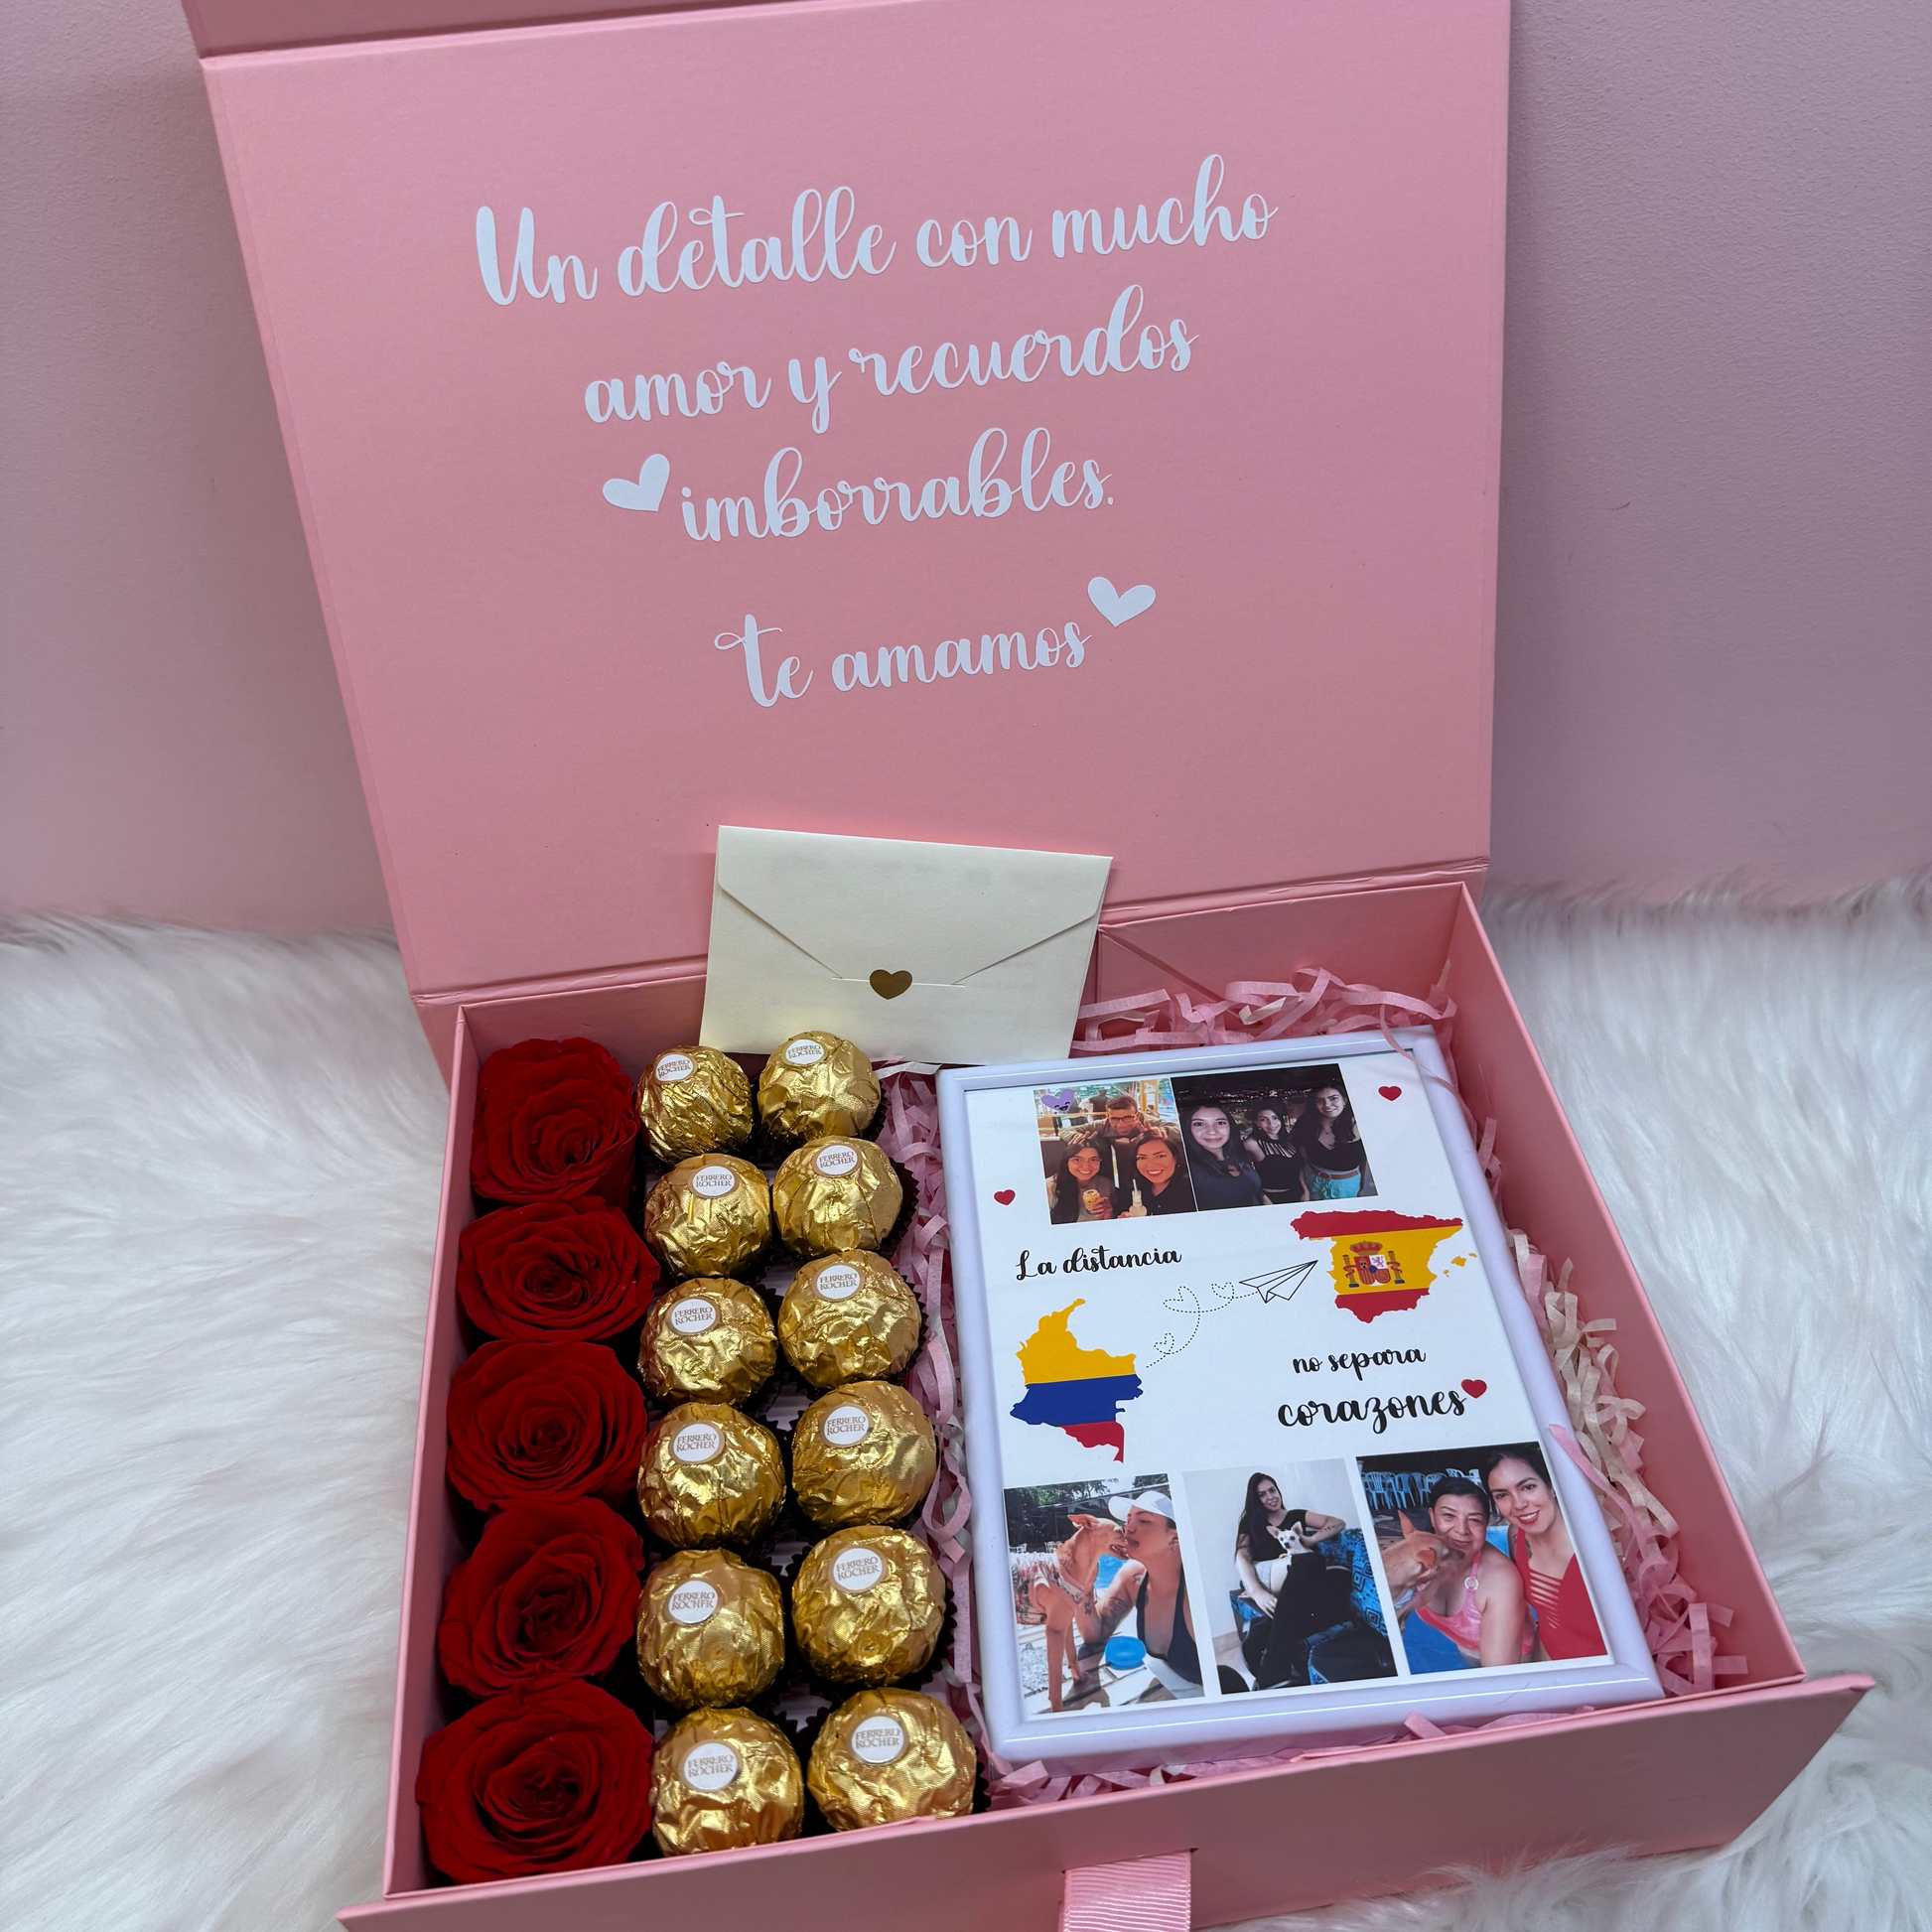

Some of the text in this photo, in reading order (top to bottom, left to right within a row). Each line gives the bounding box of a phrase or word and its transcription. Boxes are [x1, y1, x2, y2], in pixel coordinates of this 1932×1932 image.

[476, 153, 1280, 306] Un detalle con mucho
[584, 284, 1200, 434] amor y recuerdos
[681, 427, 1114, 542] imborrables.
[713, 614, 1093, 708] te amamos
[787, 1045, 821, 1054] FERRERO
[789, 1049, 823, 1059] ROCHER
[656, 1059, 690, 1072] FERRERO
[658, 1065, 692, 1078] ROCHER
[819, 1152, 854, 1163] FERRERO
[820, 1158, 855, 1168] ROCHER
[1016, 1244, 1182, 1281] La distancia
[820, 1273, 857, 1283] FERRERO
[820, 1280, 858, 1290] ROCHER
[674, 1307, 713, 1317] FERRERO
[675, 1313, 713, 1324] ROCHER
[1292, 1347, 1427, 1382] no separa
[1278, 1387, 1468, 1435] corazones
[827, 1417, 866, 1428] FERRERO
[827, 1424, 865, 1436] ROCHER
[677, 1434, 717, 1444] FERRERO
[676, 1442, 716, 1451] ROCHER
[836, 1557, 879, 1572] FERRERO
[837, 1565, 880, 1581] ROCHER
[673, 1591, 715, 1601] FERRERO
[672, 1599, 714, 1610] ROCHER
[856, 1728, 900, 1739] FERRERO
[856, 1737, 900, 1748] ROCHER
[688, 1754, 734, 1767] FERRERO
[688, 1764, 734, 1777] ROCHER
